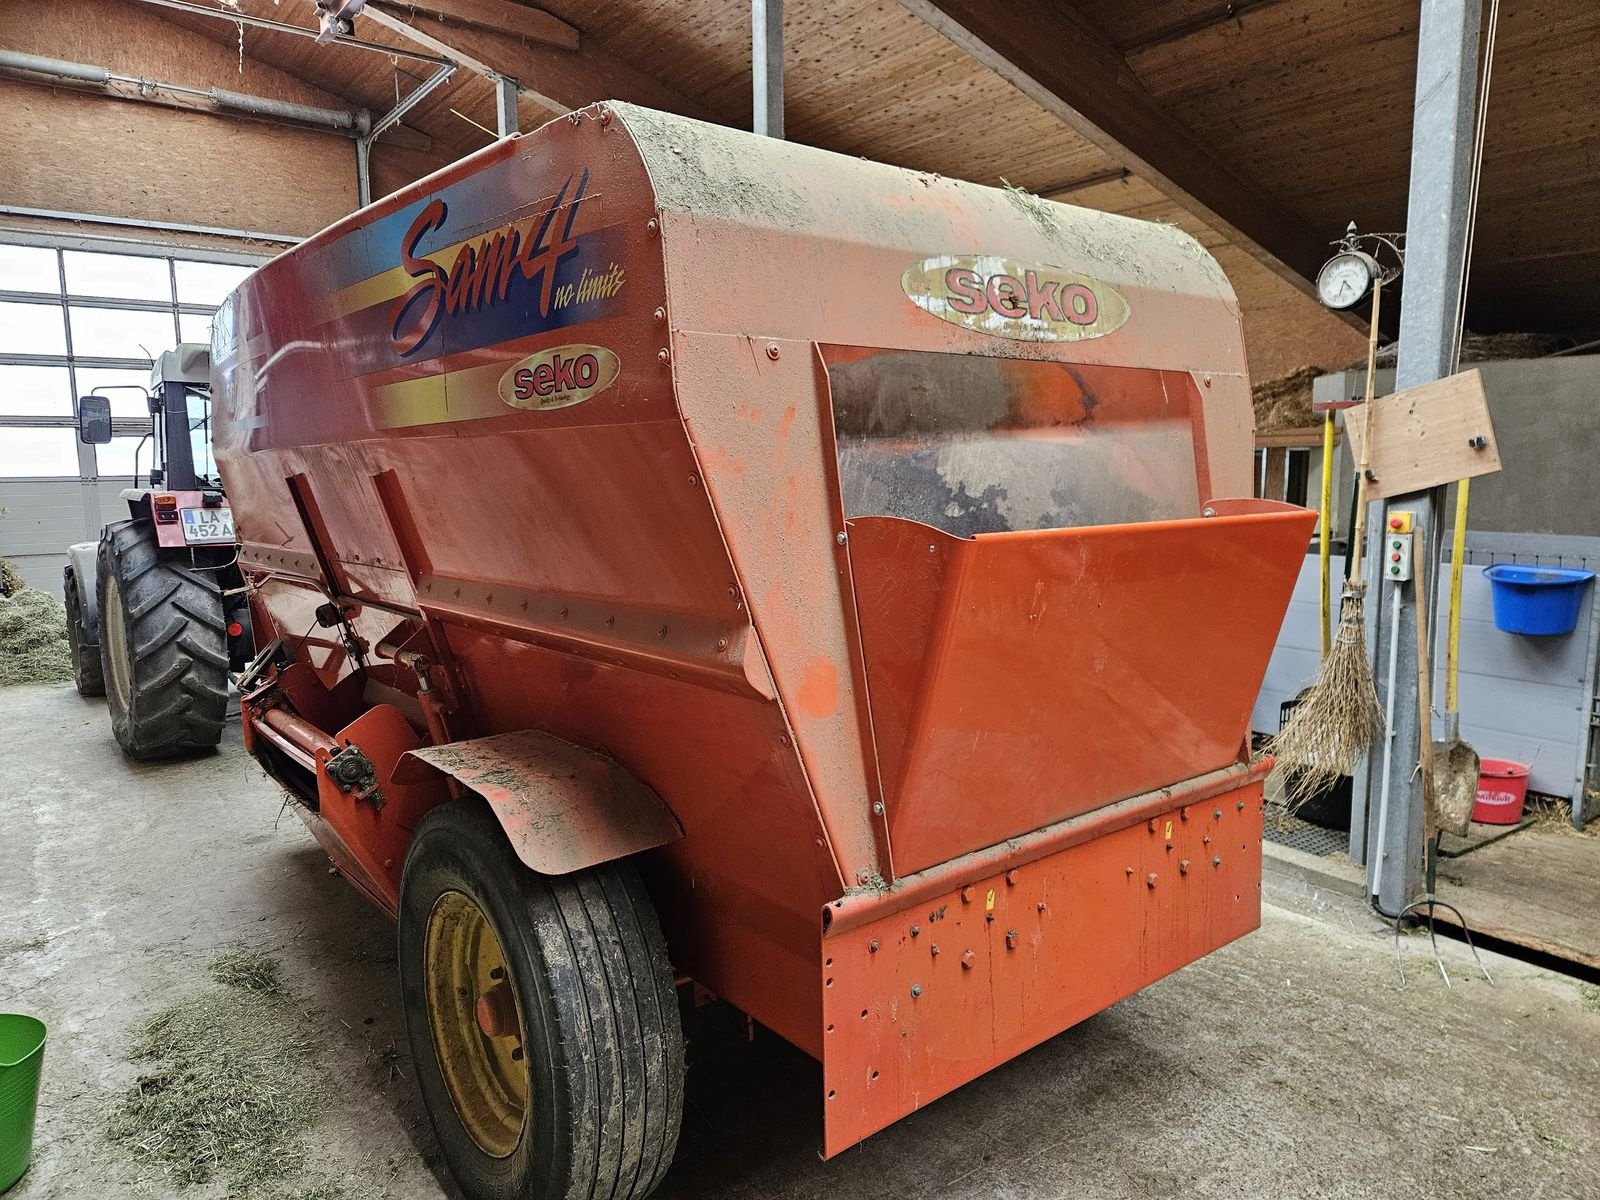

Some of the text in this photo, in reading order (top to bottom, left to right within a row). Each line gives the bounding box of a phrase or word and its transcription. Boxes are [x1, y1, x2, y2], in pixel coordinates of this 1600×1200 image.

[554, 262, 626, 310] no limits
[945, 268, 1098, 326] seko
[514, 354, 599, 400] seko
[190, 524, 219, 537] 452
[200, 511, 220, 523] LA
